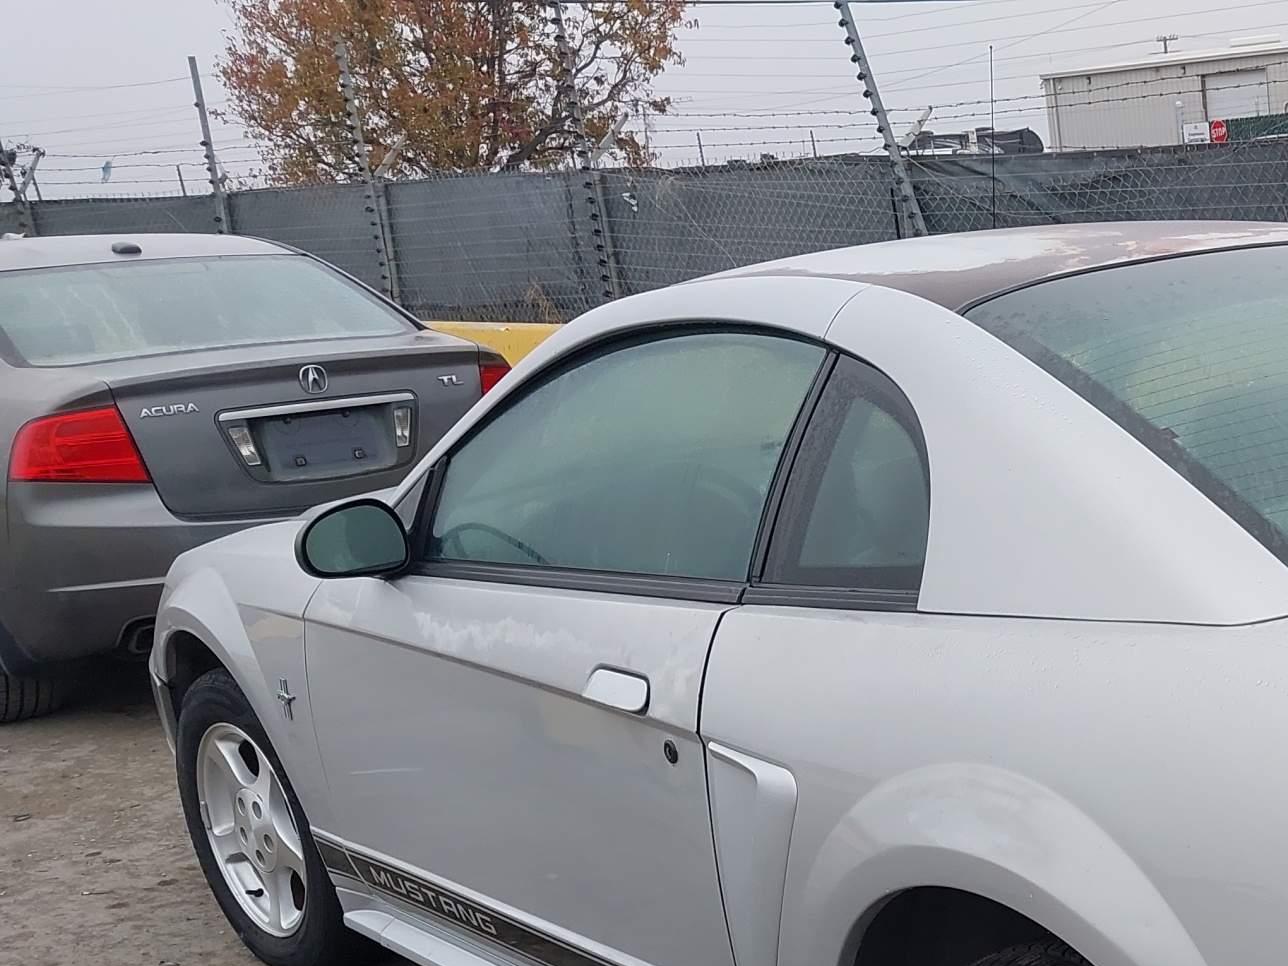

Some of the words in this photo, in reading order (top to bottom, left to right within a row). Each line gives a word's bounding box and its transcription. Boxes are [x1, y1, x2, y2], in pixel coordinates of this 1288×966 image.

[1211, 127, 1226, 138] STOP
[437, 375, 464, 386] TL
[139, 403, 199, 418] ACURA
[369, 866, 497, 935] MUSTANG
